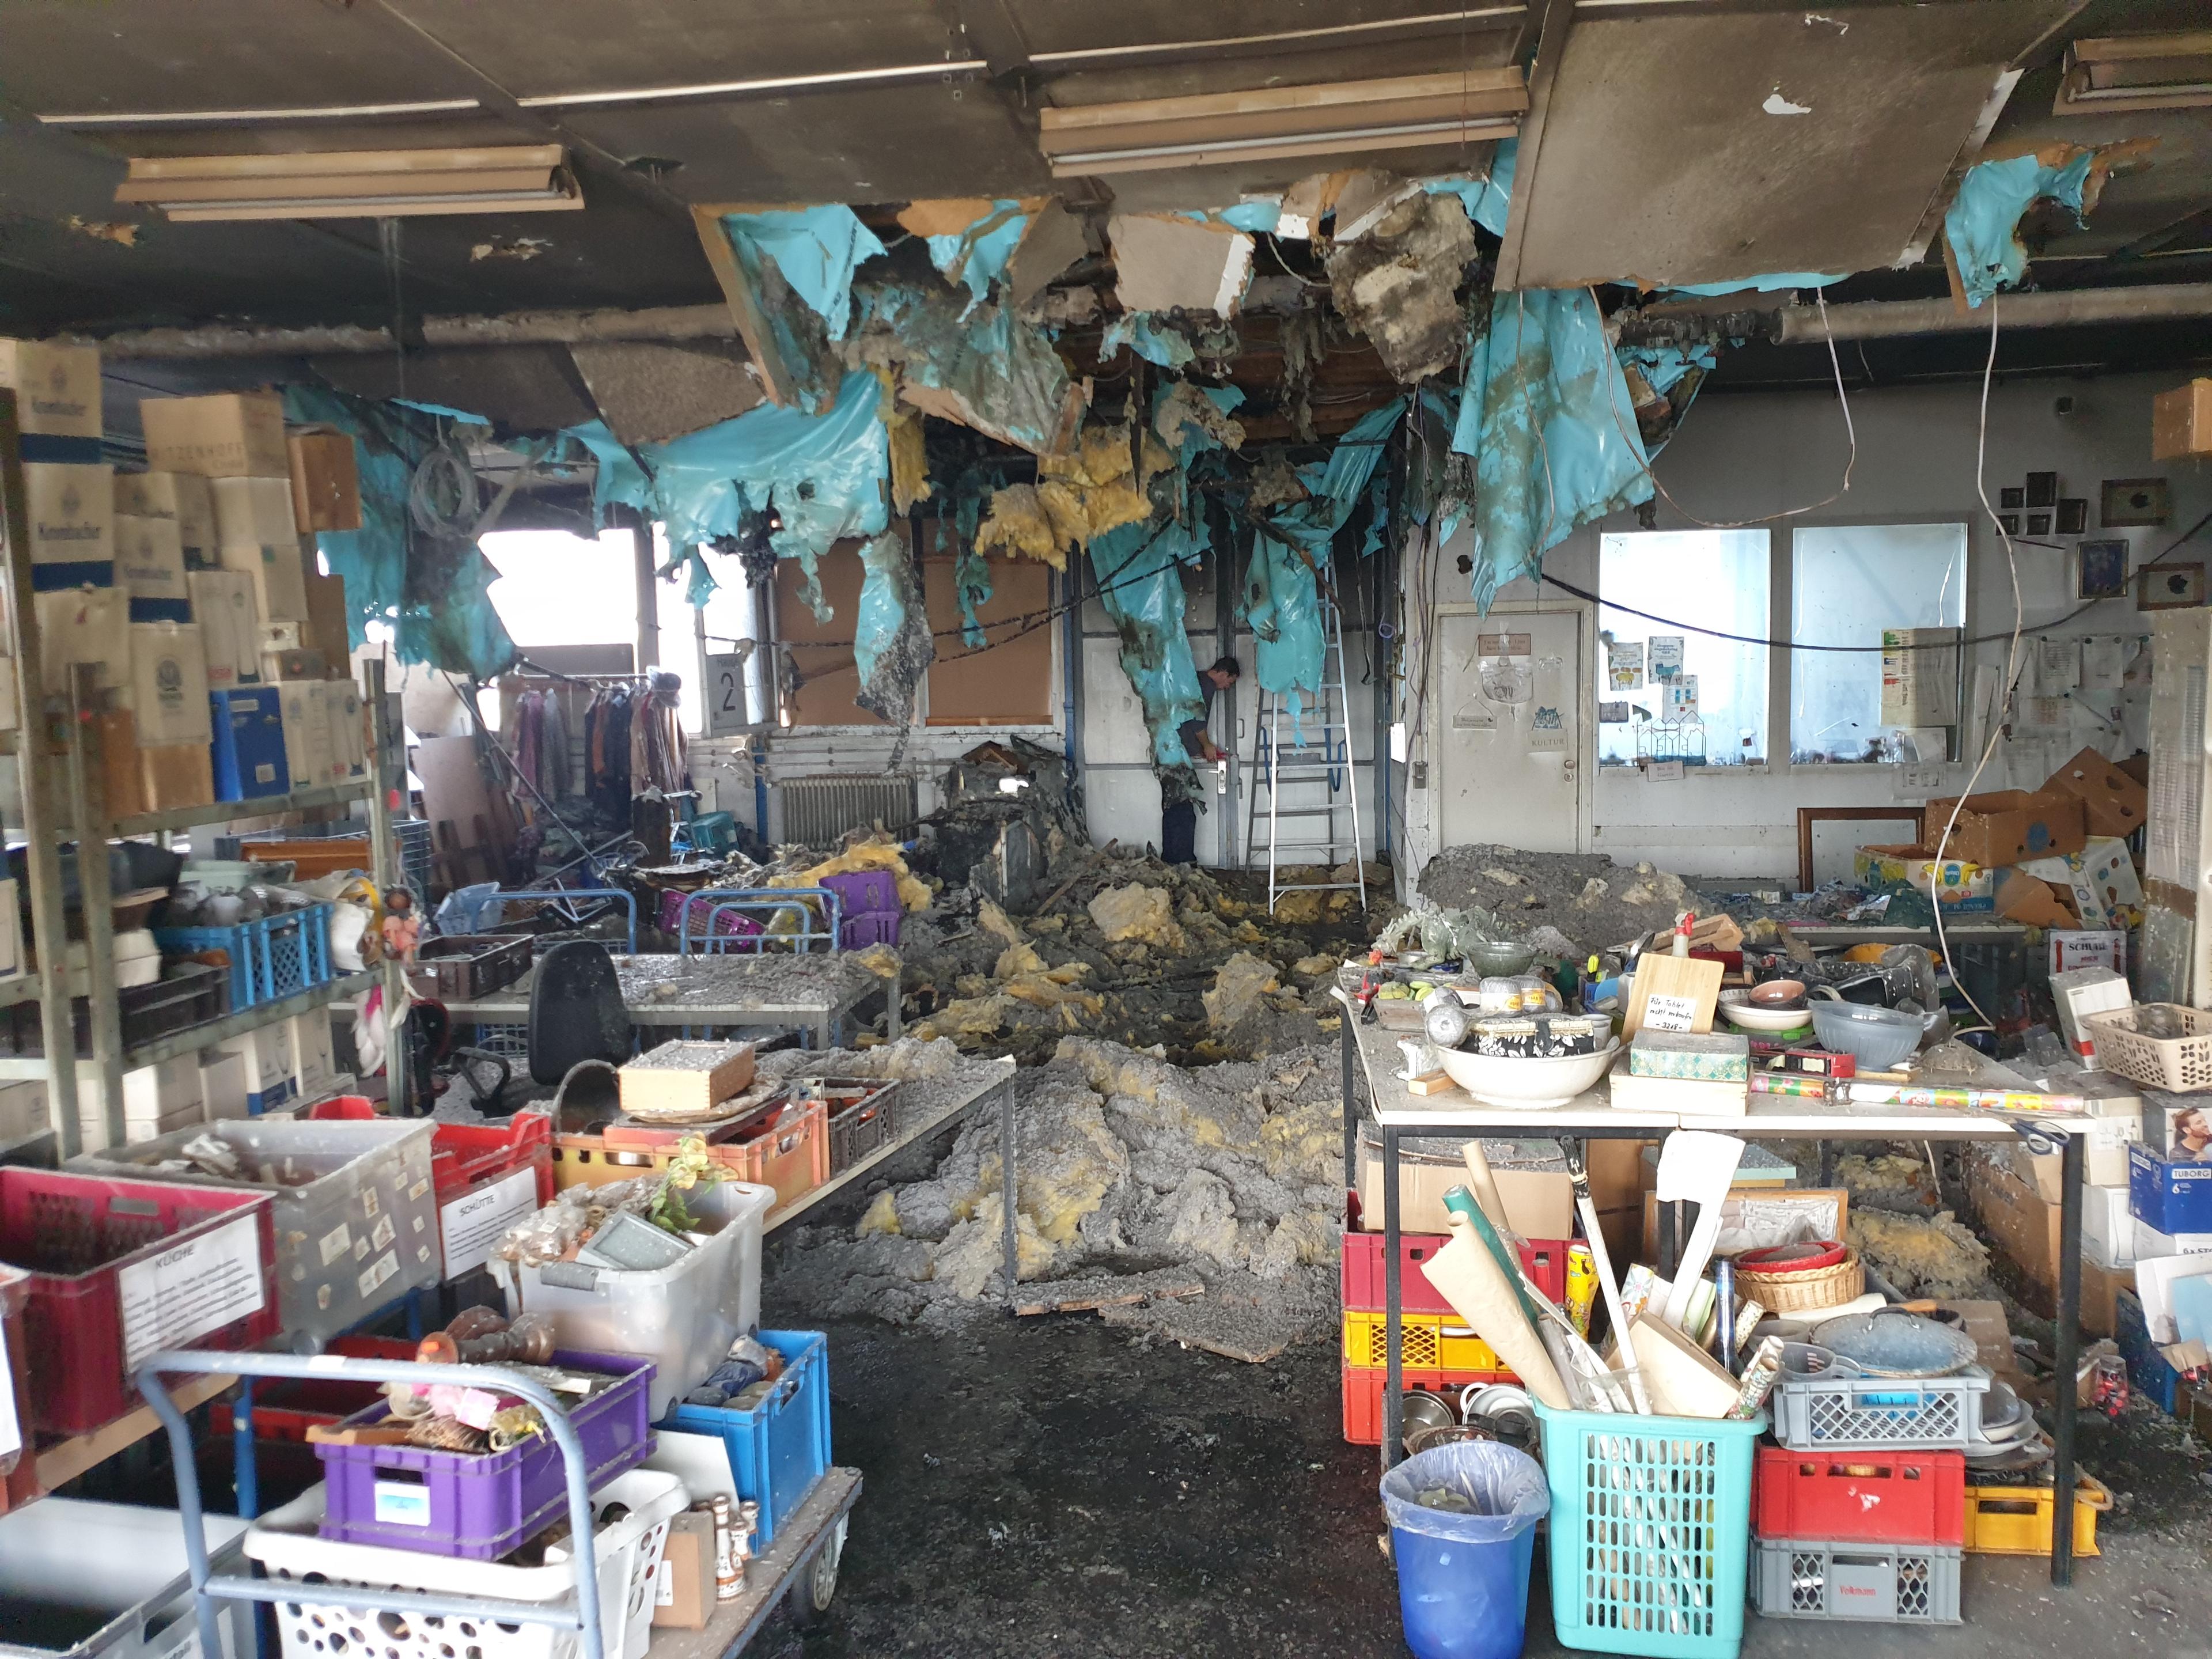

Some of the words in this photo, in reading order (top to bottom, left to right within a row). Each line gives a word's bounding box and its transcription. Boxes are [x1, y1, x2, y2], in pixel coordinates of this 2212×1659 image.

[721, 672, 736, 712] 2
[1532, 738, 1565, 747] KULTUR
[2172, 1183, 2180, 1194] 6
[460, 1194, 495, 1217] SCHÜTTE
[156, 1244, 194, 1269] KÜCHE
